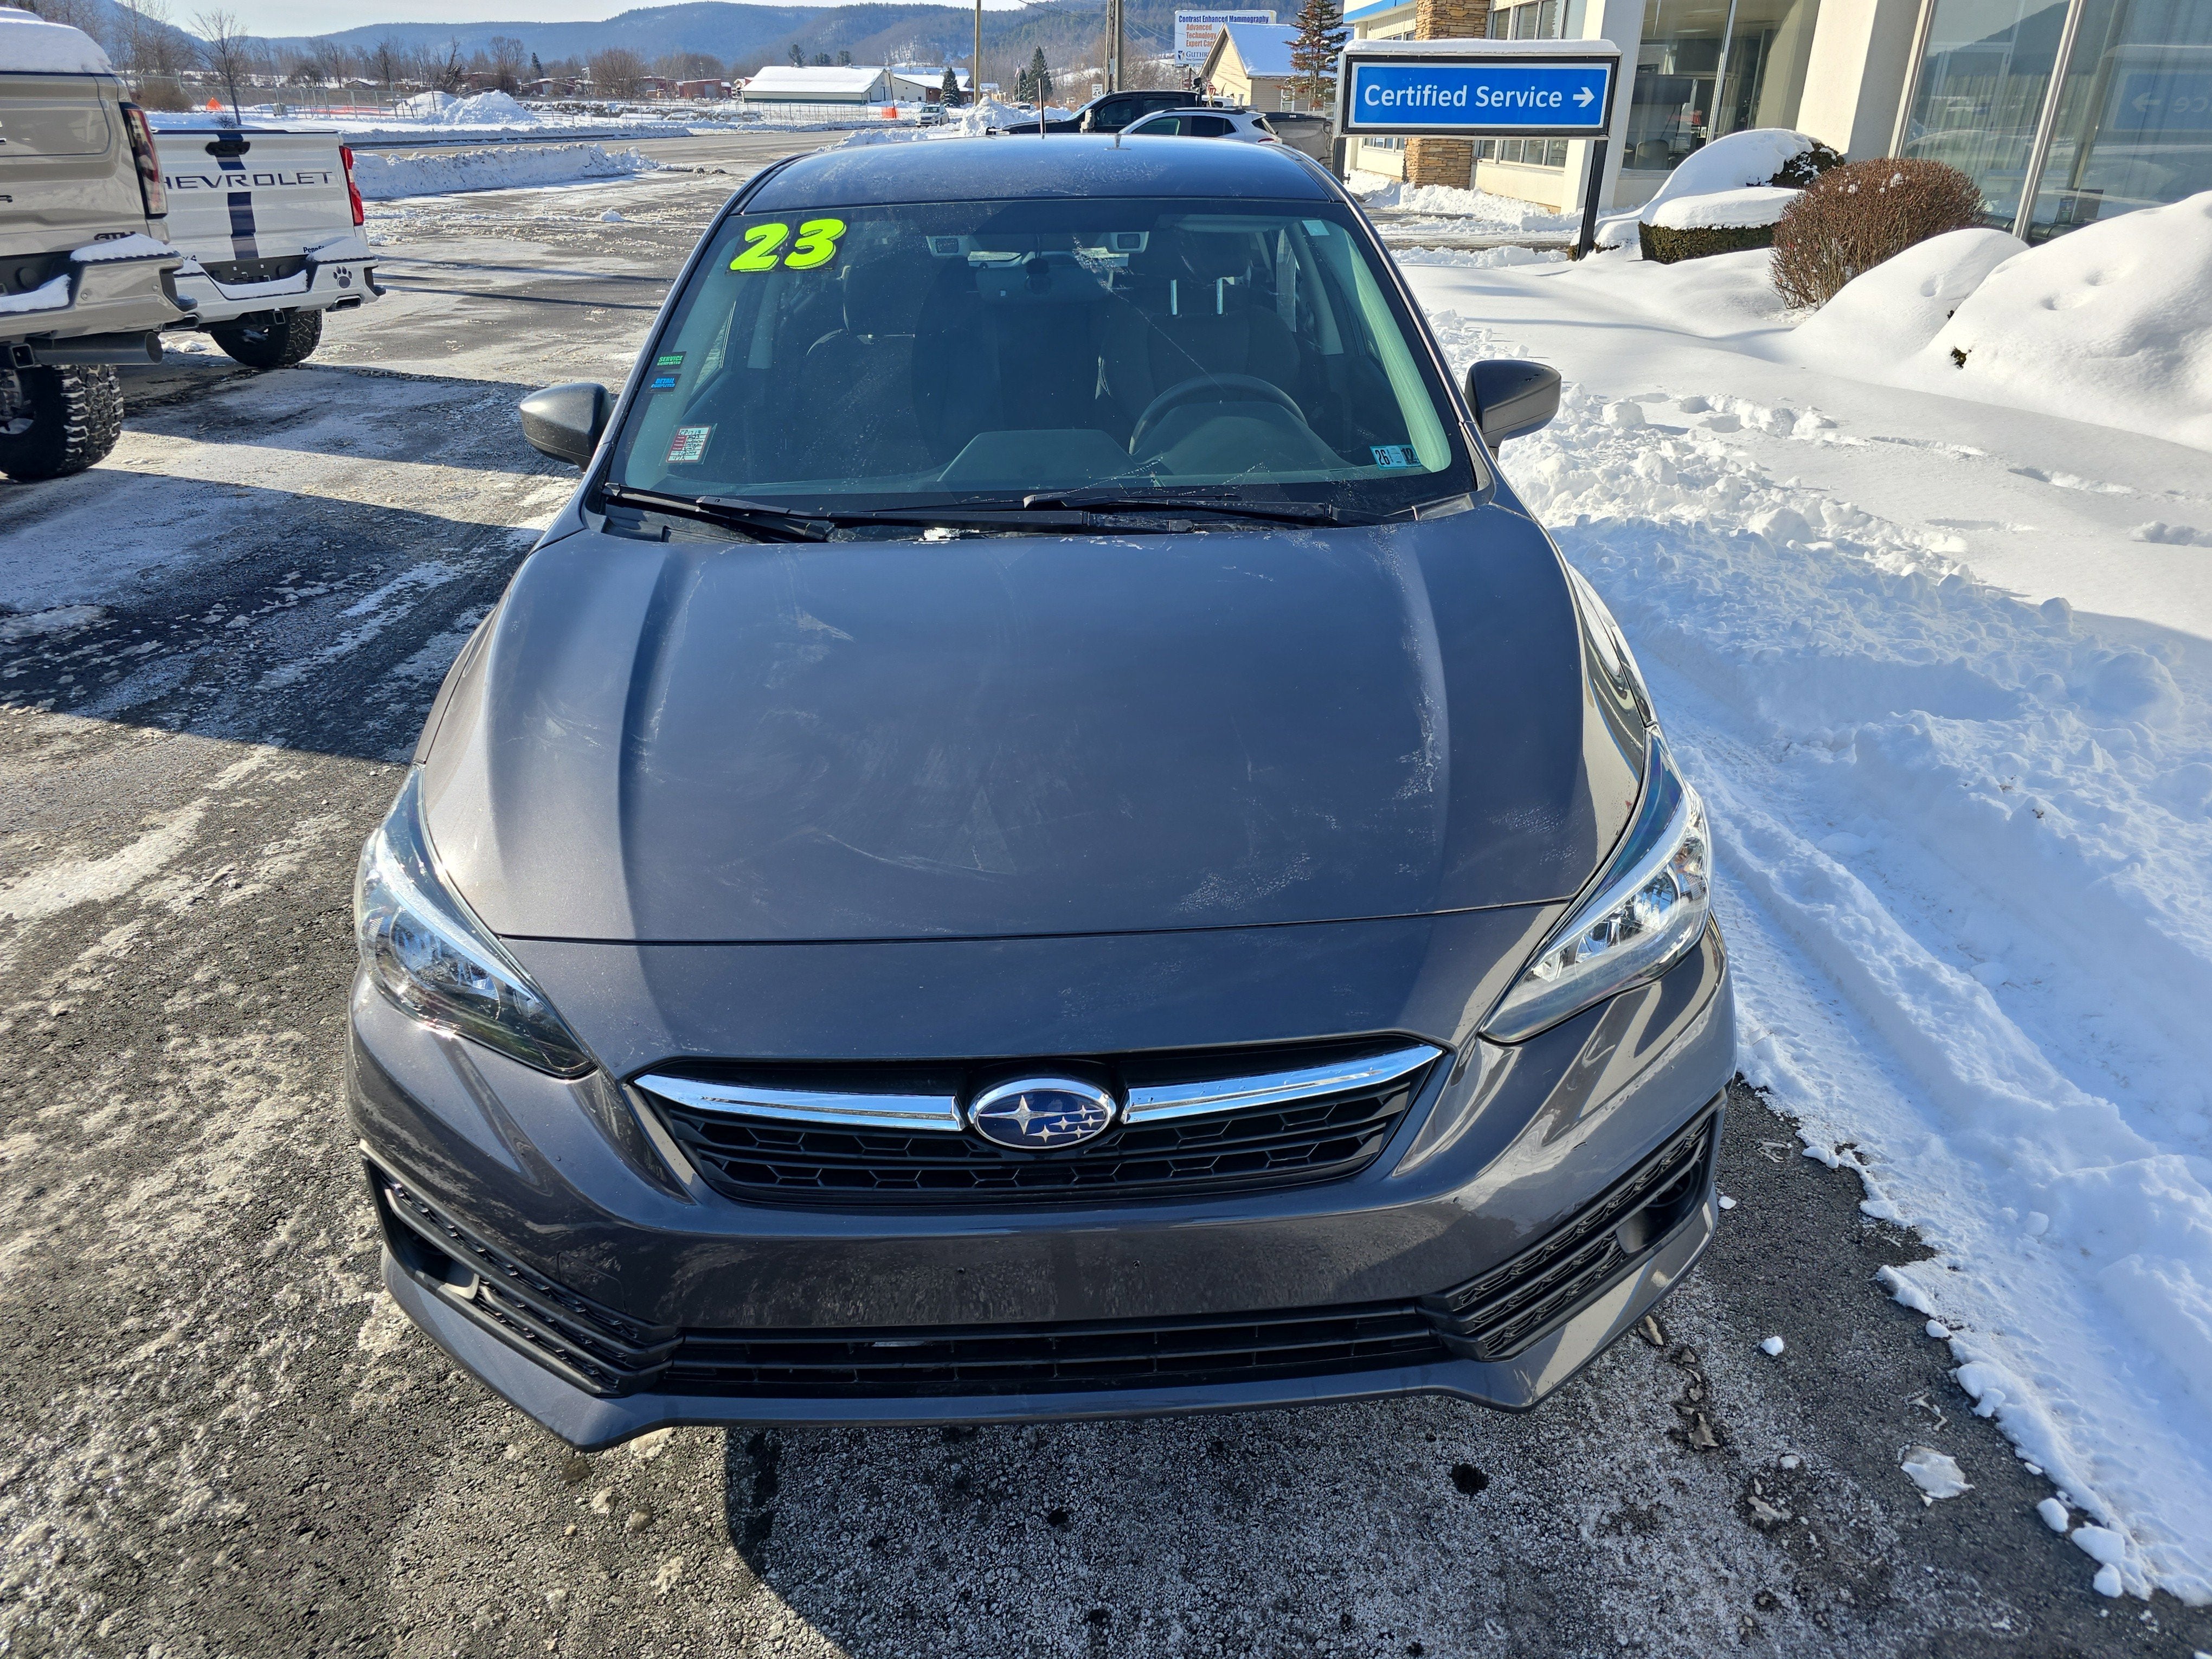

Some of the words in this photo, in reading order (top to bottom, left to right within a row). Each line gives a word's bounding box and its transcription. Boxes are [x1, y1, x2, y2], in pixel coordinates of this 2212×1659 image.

[1229, 15, 1269, 23] Mammography
[1186, 31, 1217, 40] Technology
[1364, 84, 1467, 107] Certified
[1475, 85, 1563, 108] Service
[729, 218, 847, 273] 23
[1374, 449, 1391, 465] 26
